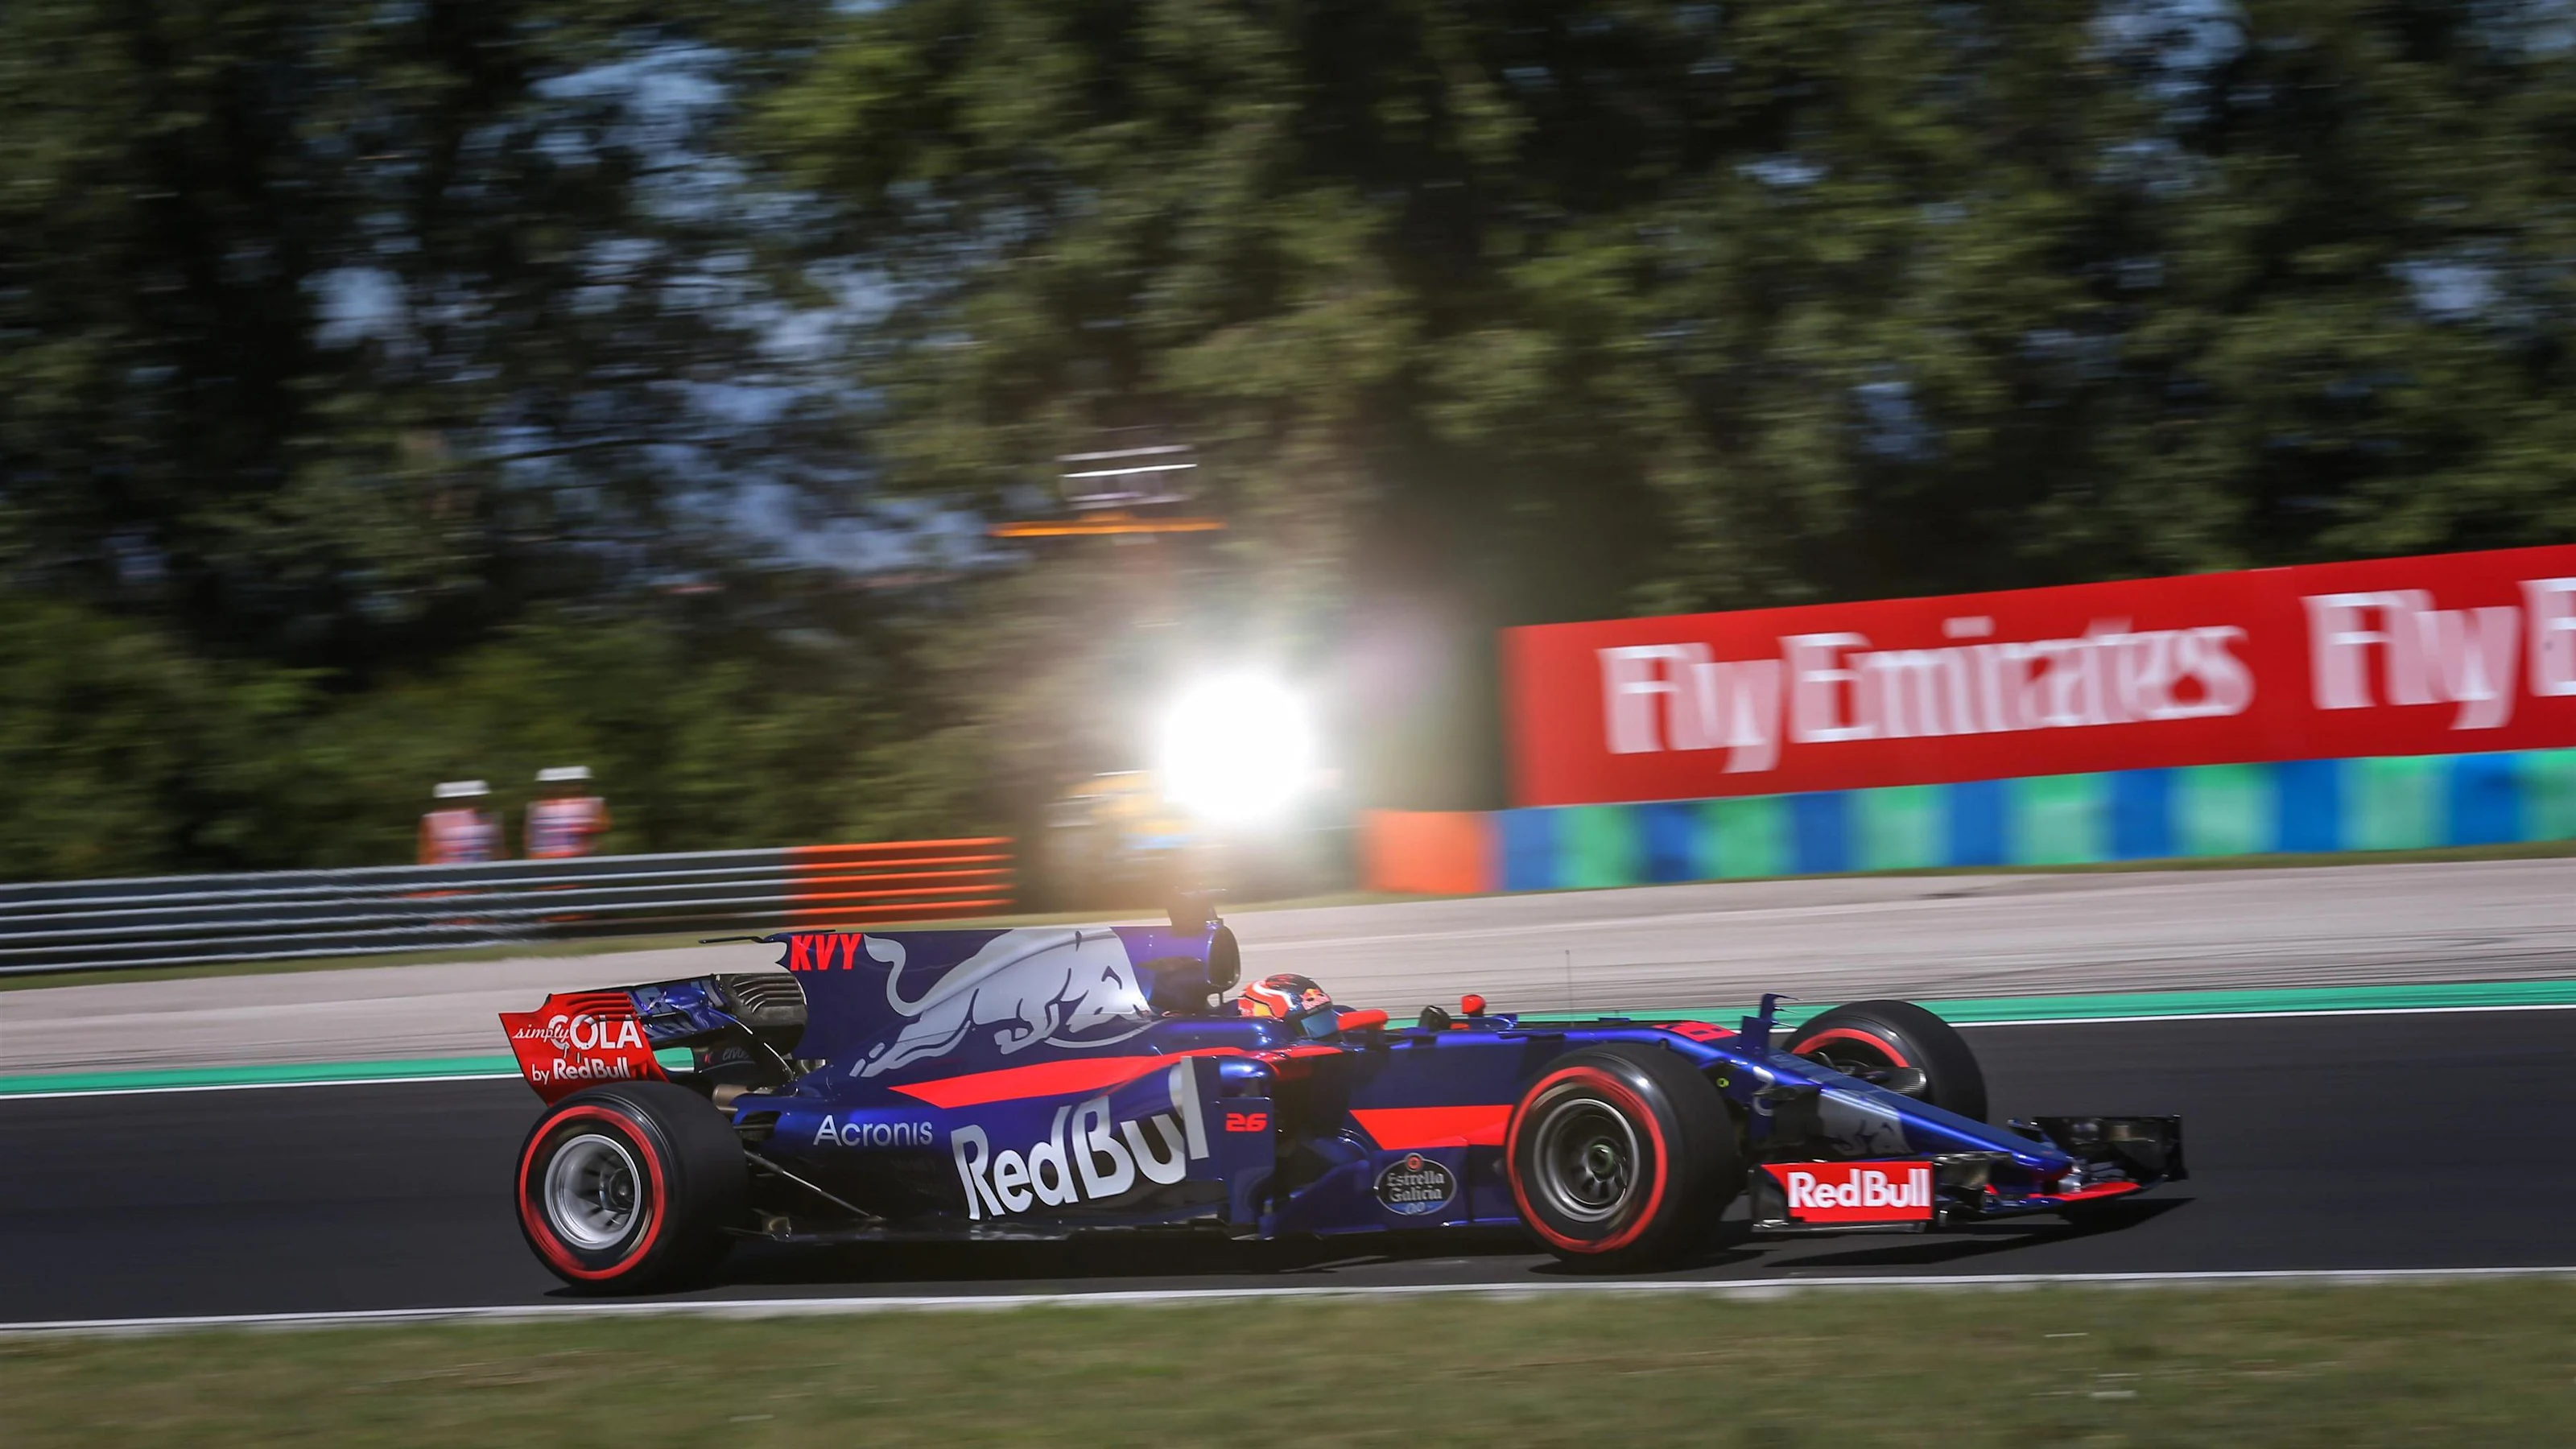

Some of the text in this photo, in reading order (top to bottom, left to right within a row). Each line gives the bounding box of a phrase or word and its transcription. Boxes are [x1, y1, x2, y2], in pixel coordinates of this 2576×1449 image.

[791, 933, 862, 971] KVY
[513, 1014, 642, 1050] simply COLA
[532, 1064, 549, 1084] by
[813, 1114, 934, 1146] Acronis
[1226, 1113, 1267, 1132] 26
[1387, 1170, 1445, 1187] Estrella
[1389, 1185, 1443, 1202] Galicia
